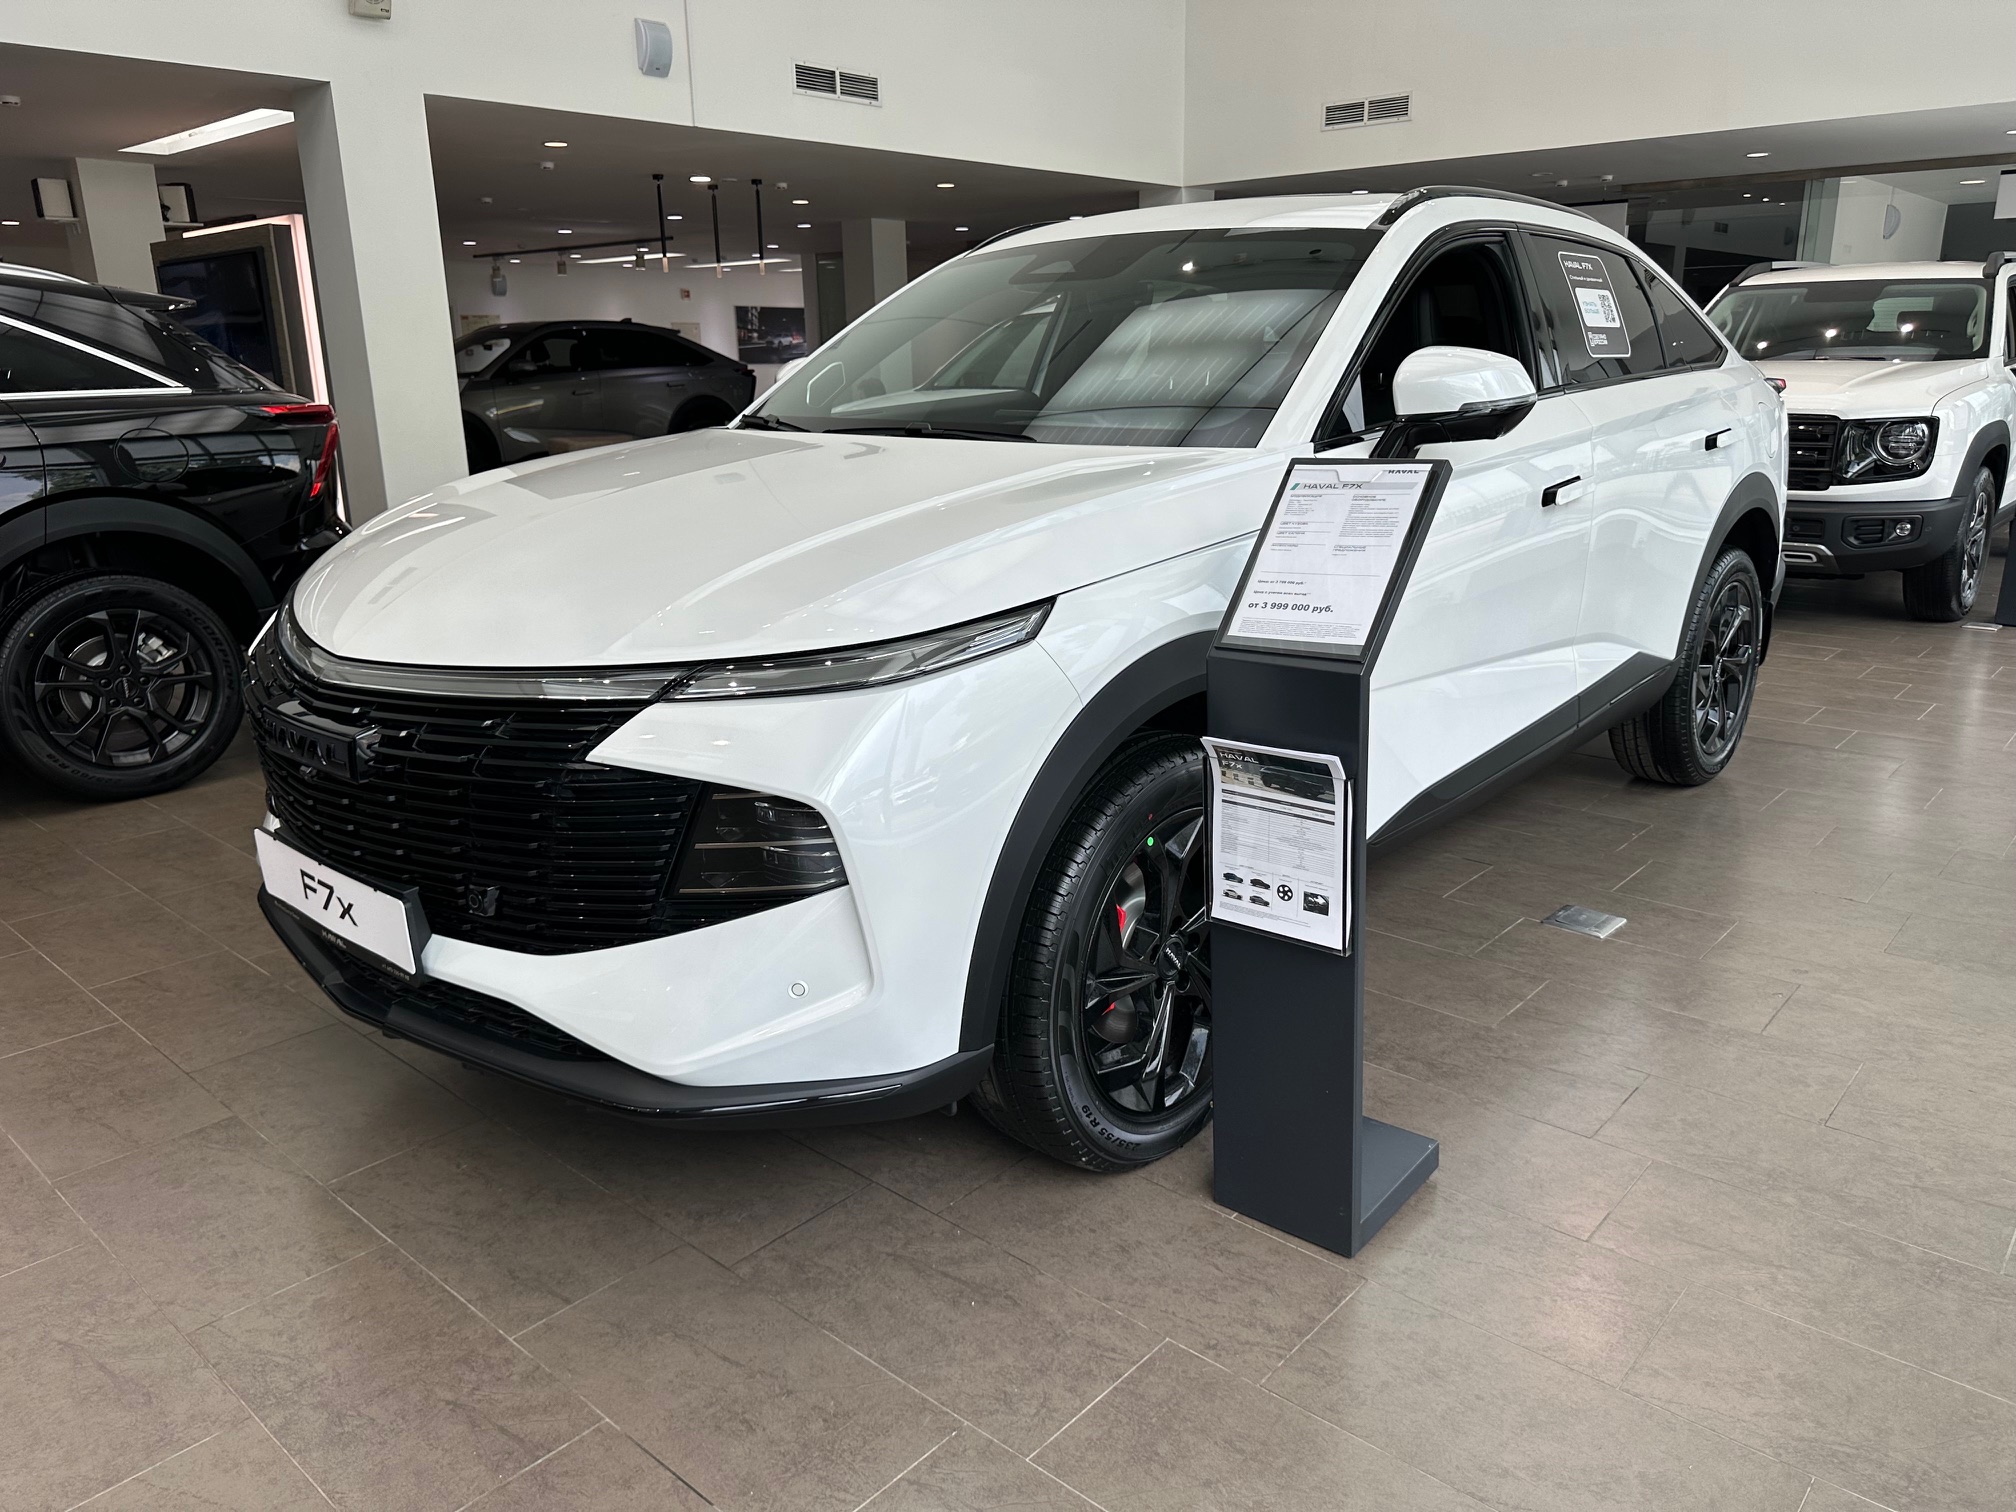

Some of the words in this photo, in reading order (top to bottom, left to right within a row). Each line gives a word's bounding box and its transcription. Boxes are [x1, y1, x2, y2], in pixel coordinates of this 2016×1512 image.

[1270, 602, 1289, 610] 999
[1291, 603, 1310, 612] 000
[1311, 605, 1334, 614] руб.
[263, 717, 348, 770] HAVAL
[1219, 752, 1259, 764] HAVAL
[1165, 947, 1181, 970] HAVAL
[1081, 1104, 1100, 1128] R19
